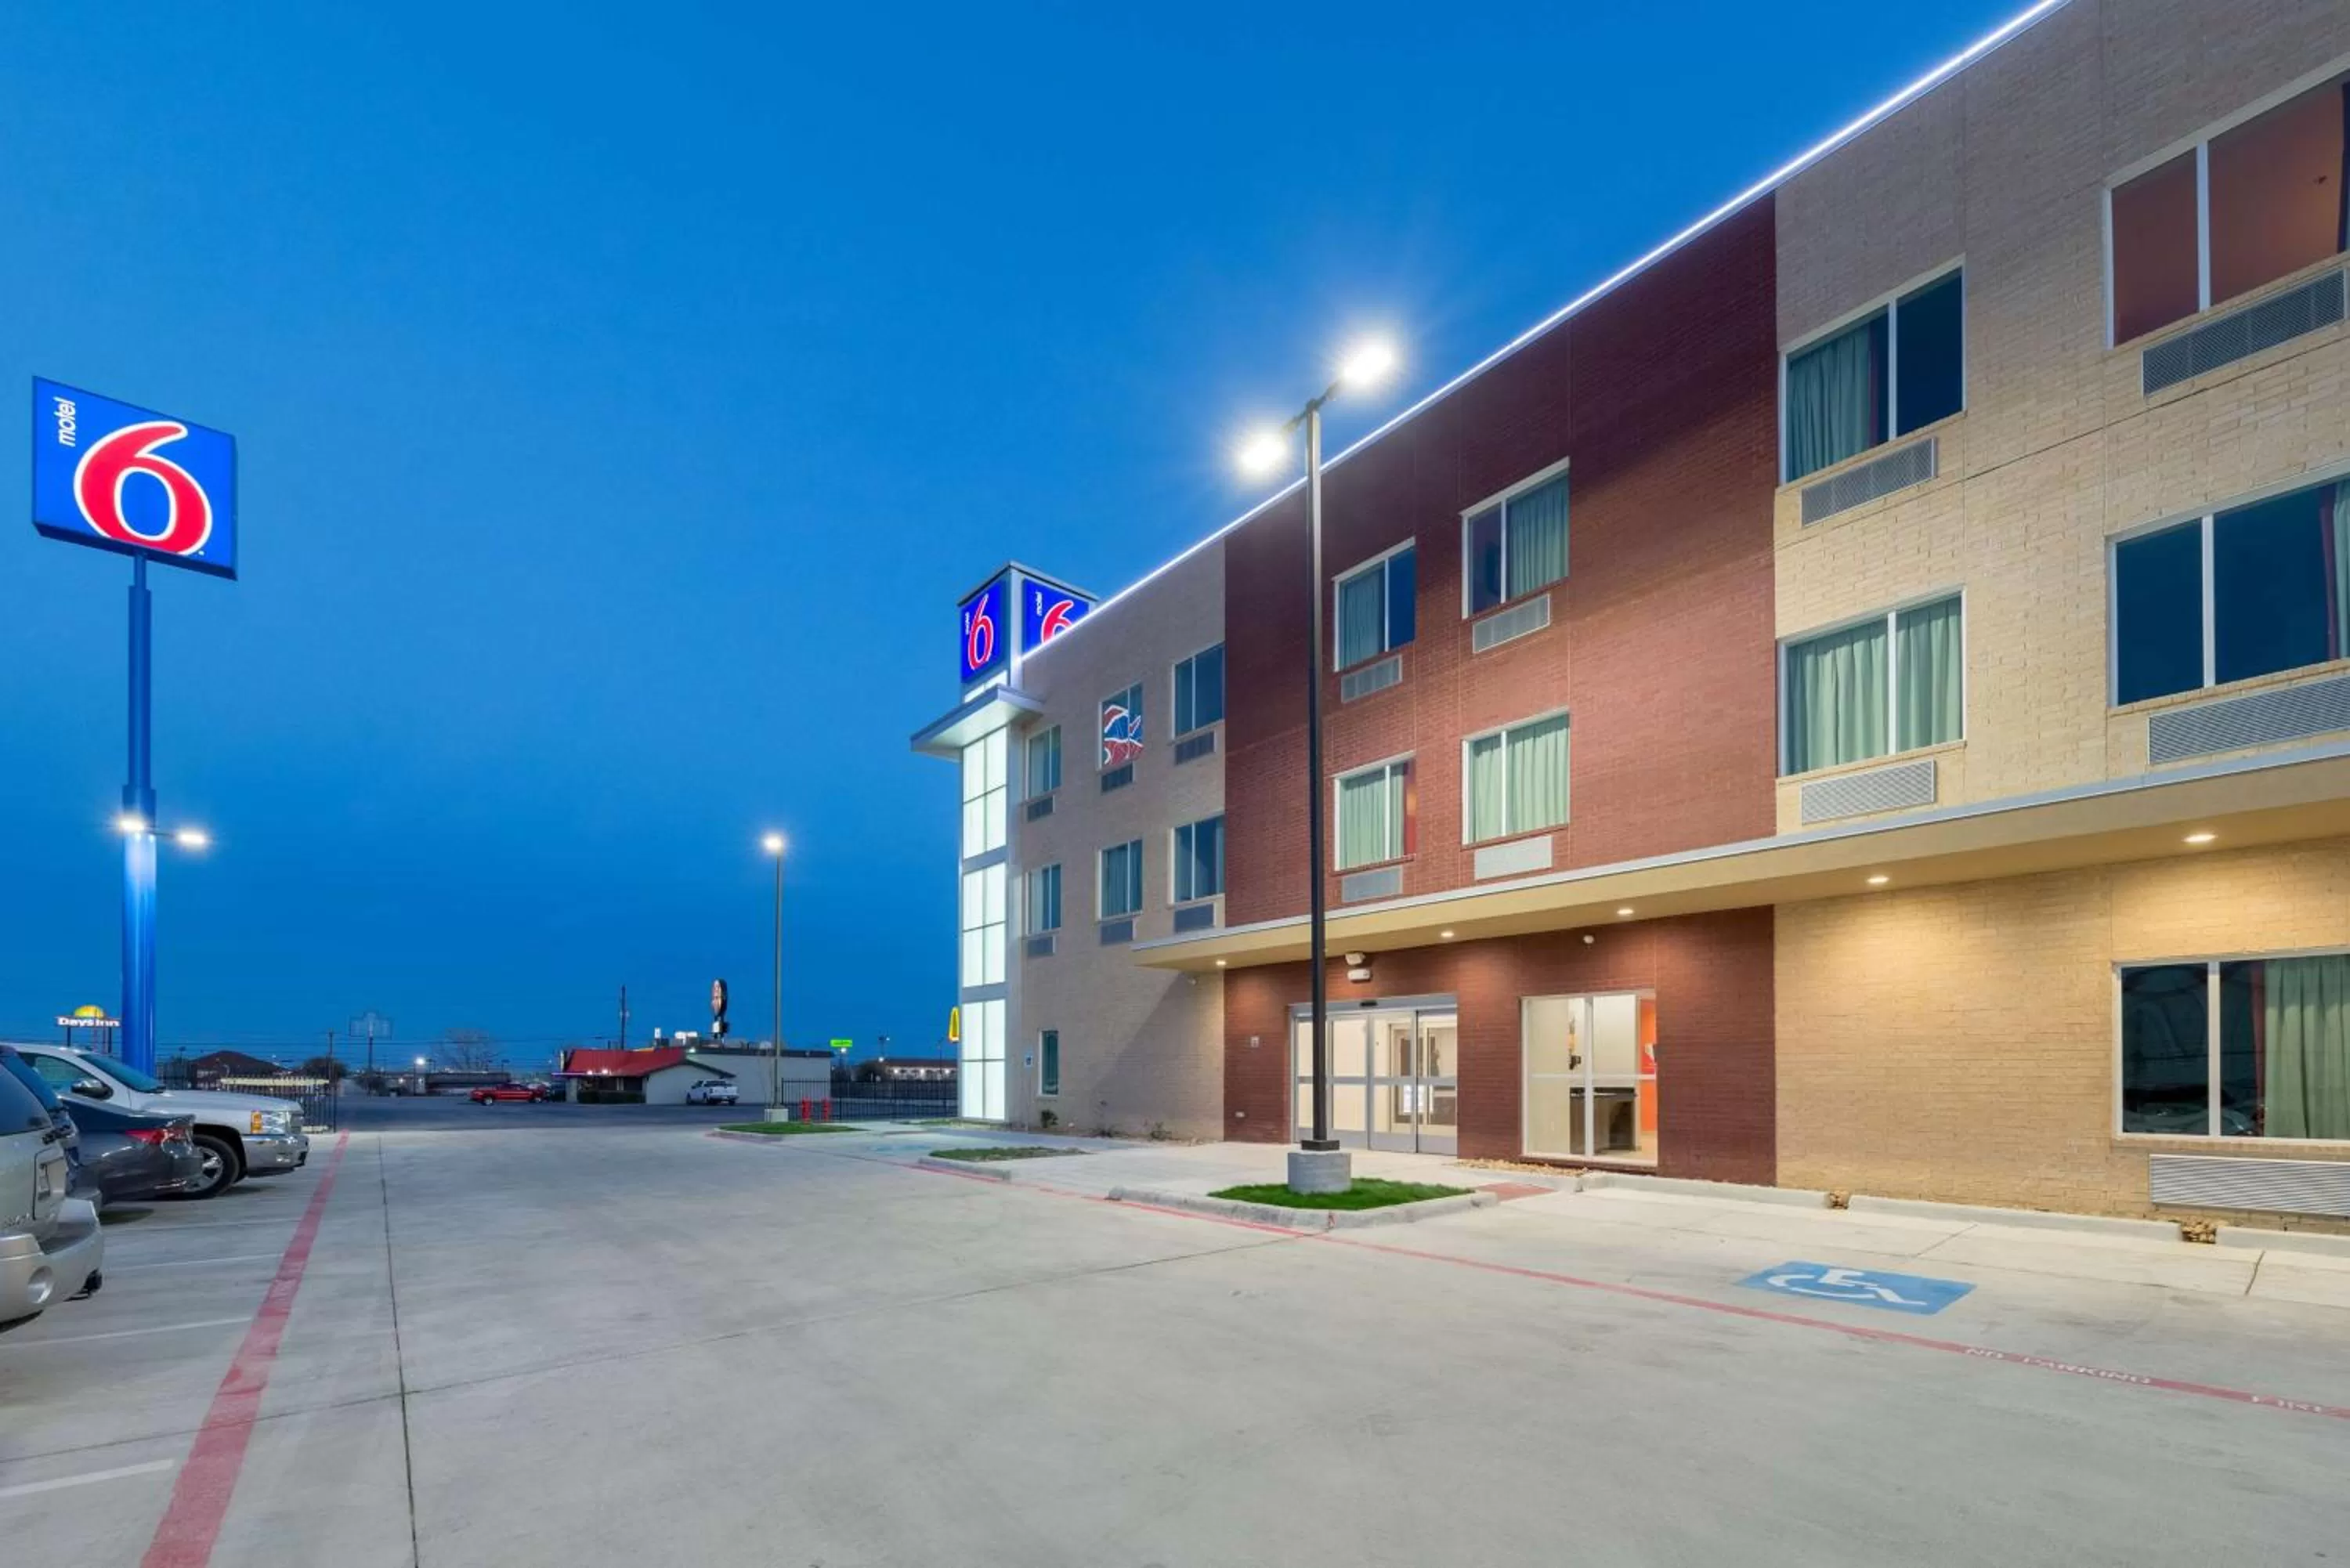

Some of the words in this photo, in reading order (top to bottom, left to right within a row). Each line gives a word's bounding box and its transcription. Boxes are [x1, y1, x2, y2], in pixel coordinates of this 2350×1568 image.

[52, 396, 76, 447] motel
[74, 421, 213, 555] 6
[968, 594, 994, 670] 6
[57, 1017, 94, 1028] Days
[95, 1018, 121, 1027] Inn
